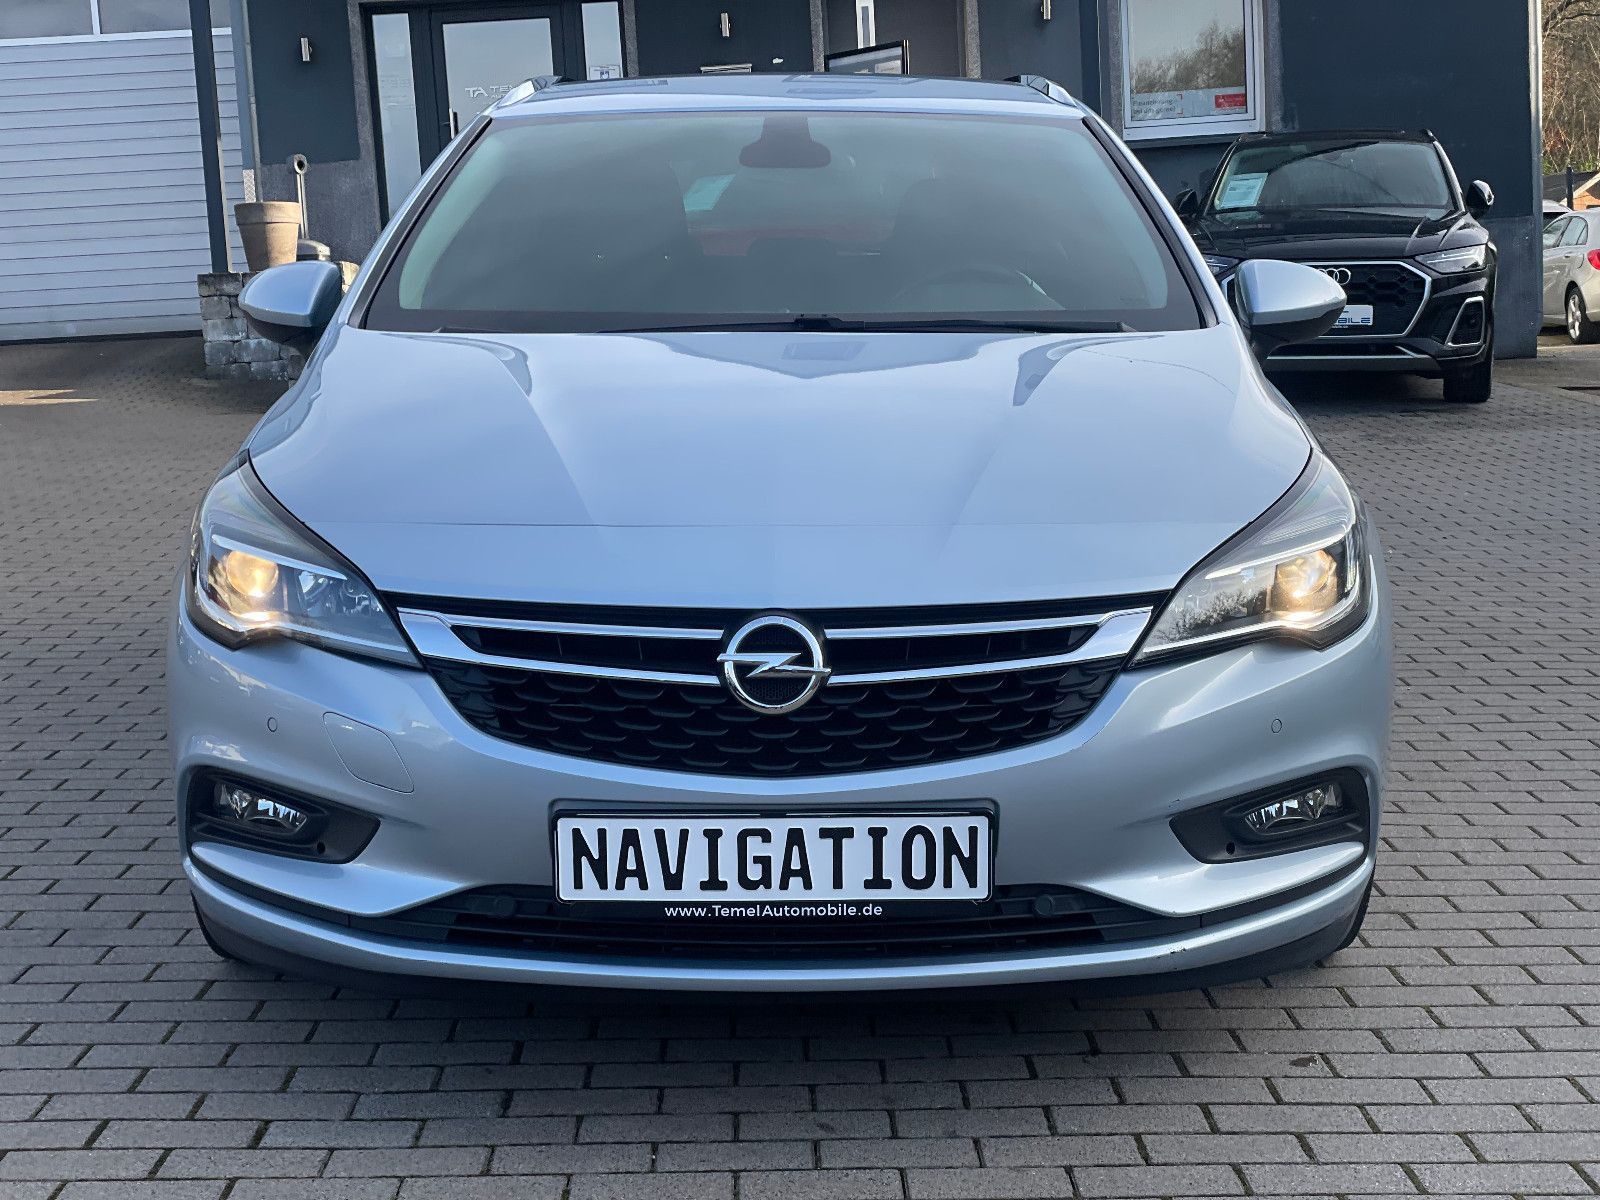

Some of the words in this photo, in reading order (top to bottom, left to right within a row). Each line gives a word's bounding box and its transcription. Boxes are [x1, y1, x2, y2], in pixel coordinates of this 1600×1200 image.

[465, 87, 488, 98] TA
[571, 824, 979, 892] NAVIGATION
[664, 903, 883, 917] www.TemelAutomobile.de
